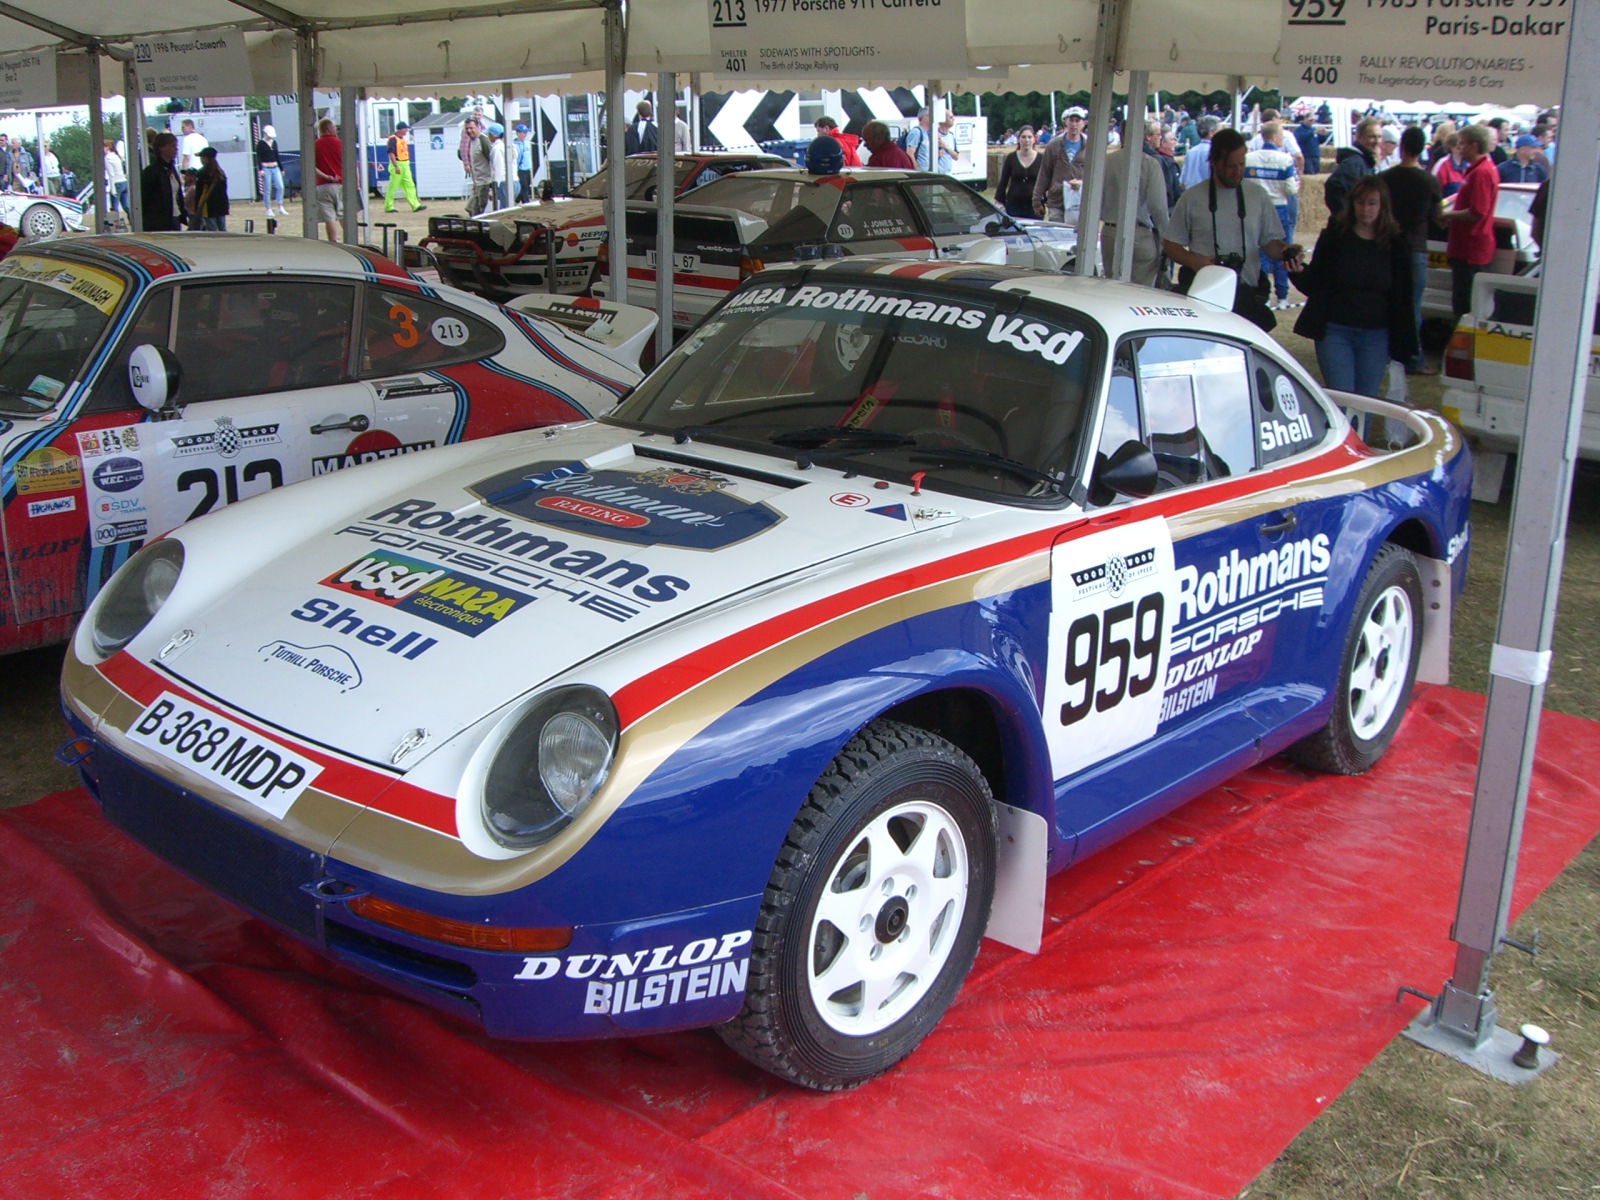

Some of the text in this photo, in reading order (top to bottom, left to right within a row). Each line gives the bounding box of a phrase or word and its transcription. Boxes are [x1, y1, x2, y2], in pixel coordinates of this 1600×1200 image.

[713, 0, 746, 21] 213
[754, 0, 787, 12] 1977
[793, 0, 846, 11] Porsche
[1426, 14, 1565, 36] Paris-Dakar
[135, 44, 151, 59] 230
[153, 38, 227, 53] 1996 Peugeot-Cosworth
[760, 48, 798, 58] SIDEWAYS
[800, 47, 822, 57] WITH
[824, 46, 875, 57] SPOTLIGHTS
[725, 58, 839, 72] 401 The Birth of Stage Rallying
[1298, 55, 1525, 71] SHELTER RALLY REVOLUTIONARIES
[1301, 67, 1504, 88] 400 The Legendary Group B Cars
[871, 219, 893, 228] JONES
[873, 227, 902, 236] HANLON
[697, 244, 733, 253] quattro
[683, 255, 695, 268] 67
[556, 270, 588, 278] RELLI
[71, 279, 113, 306] CAVANAGH
[786, 286, 986, 329] Rothmans
[389, 304, 419, 348] 3
[437, 325, 464, 339] 213
[1281, 393, 1296, 411] 959
[1260, 413, 1313, 450] Shell
[180, 446, 214, 454] FESTIVAL
[112, 499, 139, 510] SDV
[552, 499, 630, 523] RACING
[836, 494, 862, 505] E
[366, 499, 690, 603] Rothmans
[334, 525, 641, 623] PORSCHE
[1078, 582, 1106, 595] FESTIVAL
[1138, 565, 1153, 575] SPEED
[1172, 533, 1331, 625] Rothmans
[413, 595, 484, 626] électronique
[1170, 587, 1323, 657] PORSCHE
[293, 598, 439, 660] Shell
[1060, 592, 1164, 726] 959
[1165, 629, 1263, 691] DUNLOP
[1158, 674, 1218, 724] BILSTEIN
[210, 736, 306, 799] MDP
[513, 929, 753, 979] DUNLOP
[584, 958, 749, 1015] BILSTEIN
